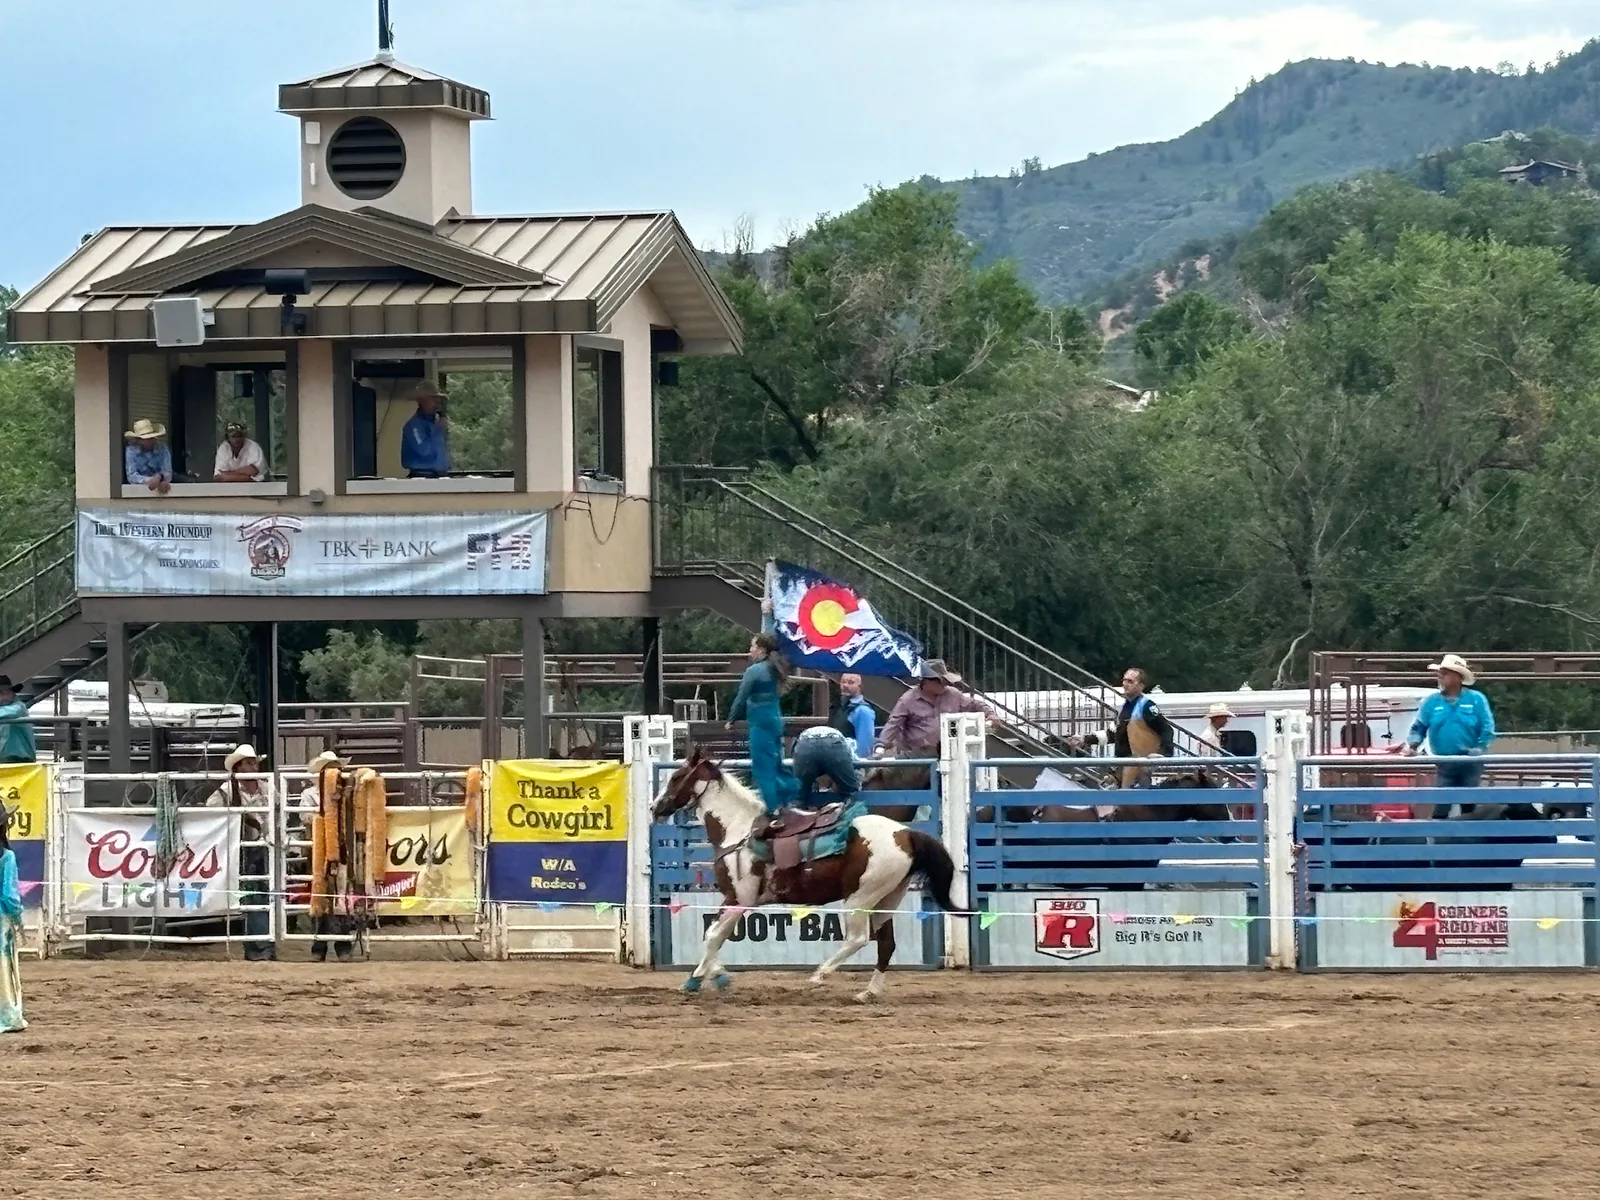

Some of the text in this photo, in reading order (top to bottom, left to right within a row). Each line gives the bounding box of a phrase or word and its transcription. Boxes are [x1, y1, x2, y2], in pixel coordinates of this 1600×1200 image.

[167, 522, 212, 538] ROUNDUP
[319, 540, 438, 557] TBK BANK
[517, 780, 602, 800] Thank a
[507, 804, 614, 837] Cowgirl
[386, 832, 453, 867] ors
[1438, 905, 1508, 918] CORNERS
[1438, 919, 1509, 933] ROOFING
[1115, 930, 1137, 945] Big
[1165, 930, 1189, 943] Got
